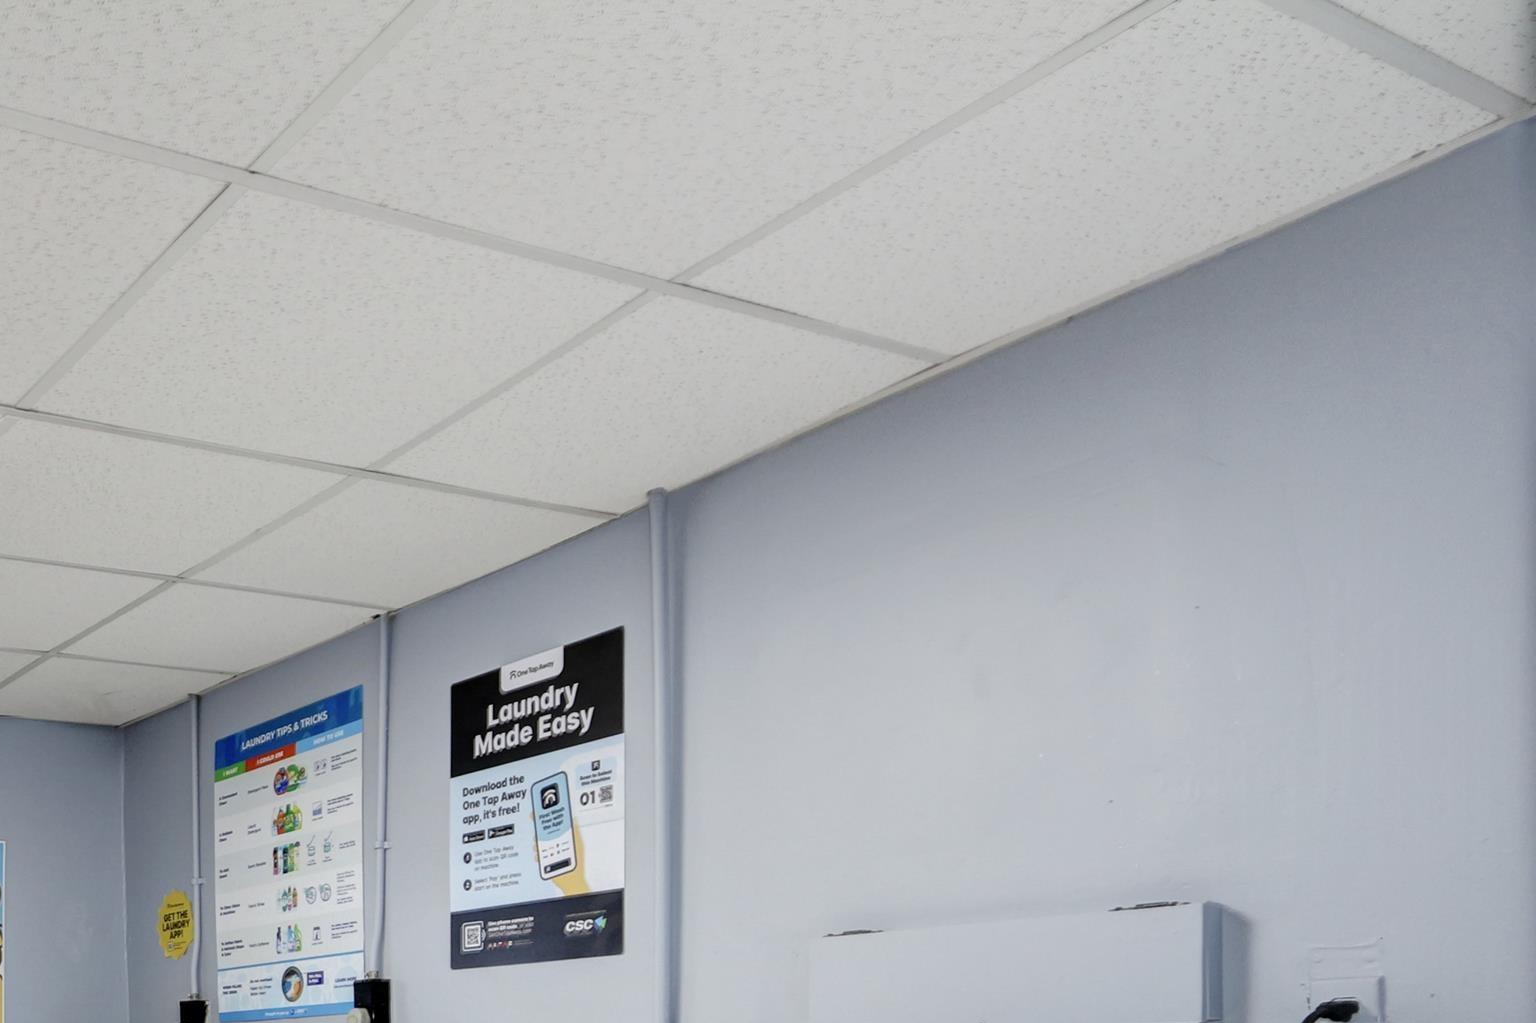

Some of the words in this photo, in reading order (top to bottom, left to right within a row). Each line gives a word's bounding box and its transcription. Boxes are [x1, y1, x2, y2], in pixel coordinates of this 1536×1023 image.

[516, 667, 528, 678] One
[528, 664, 539, 675] Tap
[539, 661, 554, 672] Away
[487, 682, 579, 729] Laundry
[240, 730, 275, 751] LAUNDRY
[276, 724, 292, 738] TIPS
[293, 722, 299, 732] &
[300, 710, 328, 728] TRICKS
[473, 723, 534, 760] Made
[537, 706, 595, 742] Easy
[462, 778, 507, 797] Download
[509, 775, 525, 786] the
[462, 800, 481, 810] One
[482, 796, 499, 806] Tap
[501, 788, 527, 801] Away
[580, 790, 596, 806] 01
[462, 815, 482, 826] app,
[483, 809, 497, 820] it's
[498, 803, 521, 816] free!
[162, 919, 191, 933] LAUNDRY
[164, 912, 175, 922] GET
[176, 909, 188, 920] THE
[565, 918, 594, 933] CSC
